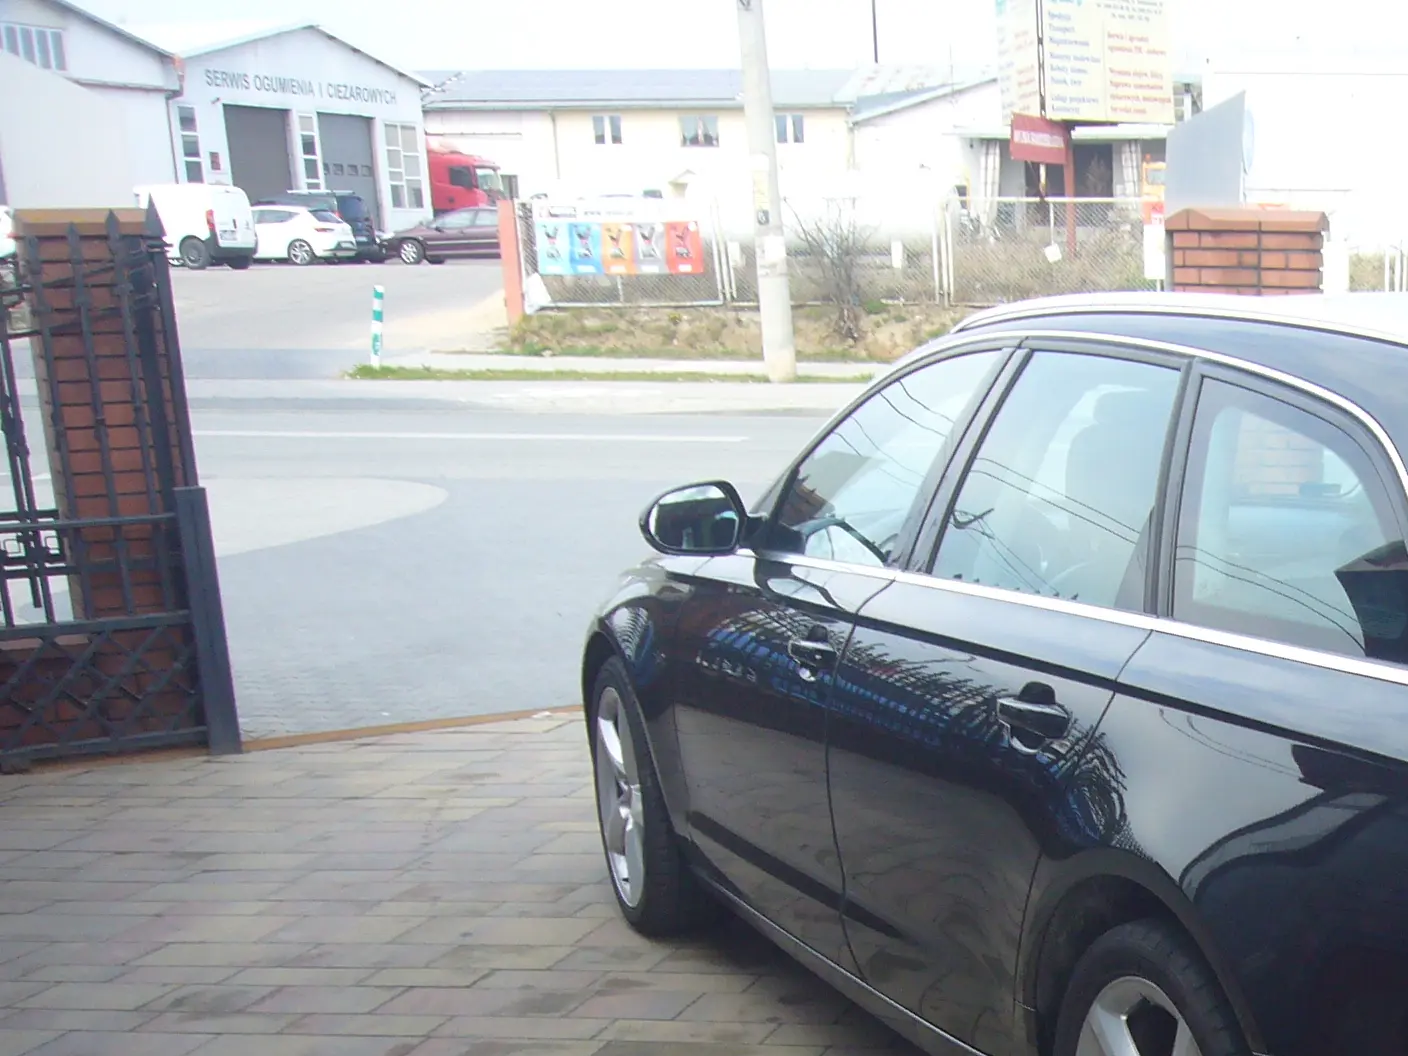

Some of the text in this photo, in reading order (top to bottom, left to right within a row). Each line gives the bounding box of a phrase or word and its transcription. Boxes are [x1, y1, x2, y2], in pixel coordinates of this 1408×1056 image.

[205, 69, 250, 89] SERWIS
[254, 75, 315, 96] OGUMIENIA
[319, 82, 323, 97] I
